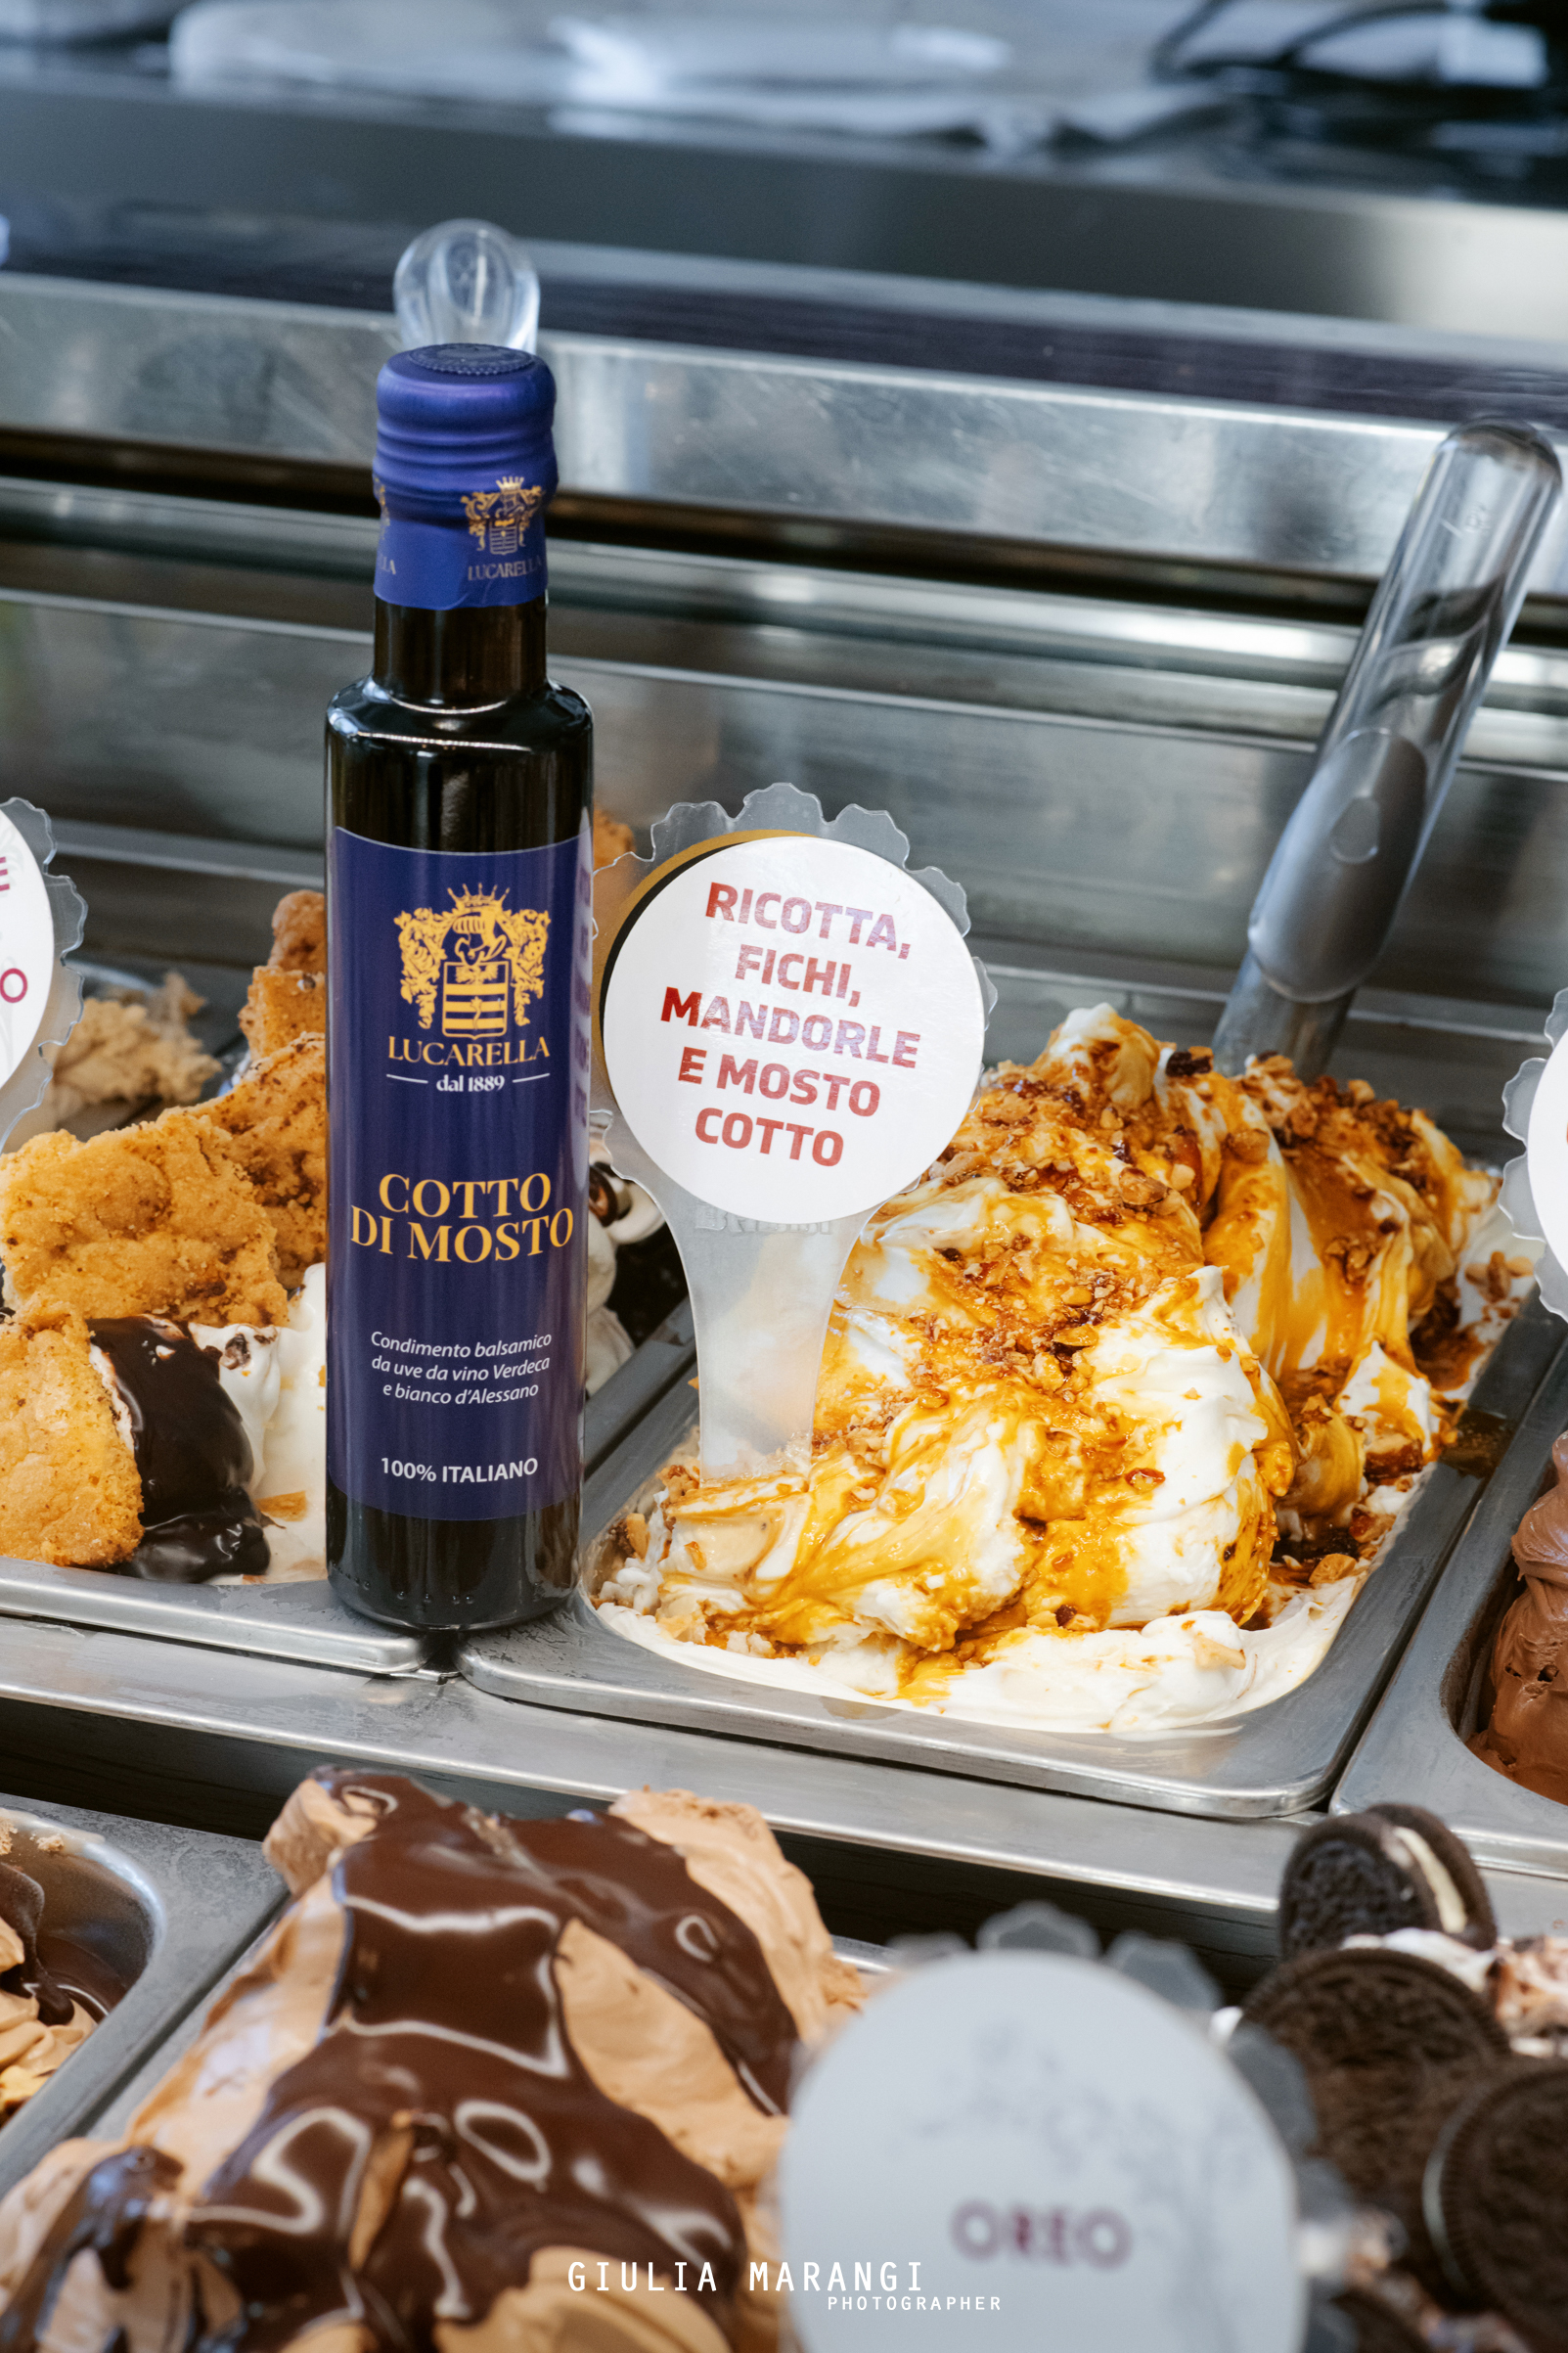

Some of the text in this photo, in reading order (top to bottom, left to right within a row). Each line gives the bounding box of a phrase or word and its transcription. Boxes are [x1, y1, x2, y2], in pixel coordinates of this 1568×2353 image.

[705, 882, 911, 960] RICOTTA,
[735, 943, 862, 1008] FICHI,
[387, 1035, 551, 1066] LUCARELLA
[660, 986, 921, 1069] MANDORLE
[436, 1074, 506, 1092] dal 1889
[678, 1046, 881, 1117] E MOSTO
[694, 1107, 844, 1167] COTTO
[379, 1173, 552, 1219] COTTO
[350, 1204, 574, 1264] DI MOSTO
[371, 1331, 553, 1358] Condimento balsamico
[371, 1355, 551, 1381] da uve da vino Verdeca
[382, 1384, 393, 1396] e
[394, 1382, 452, 1405] bianco
[381, 1457, 538, 1483] 100% ITALIANO
